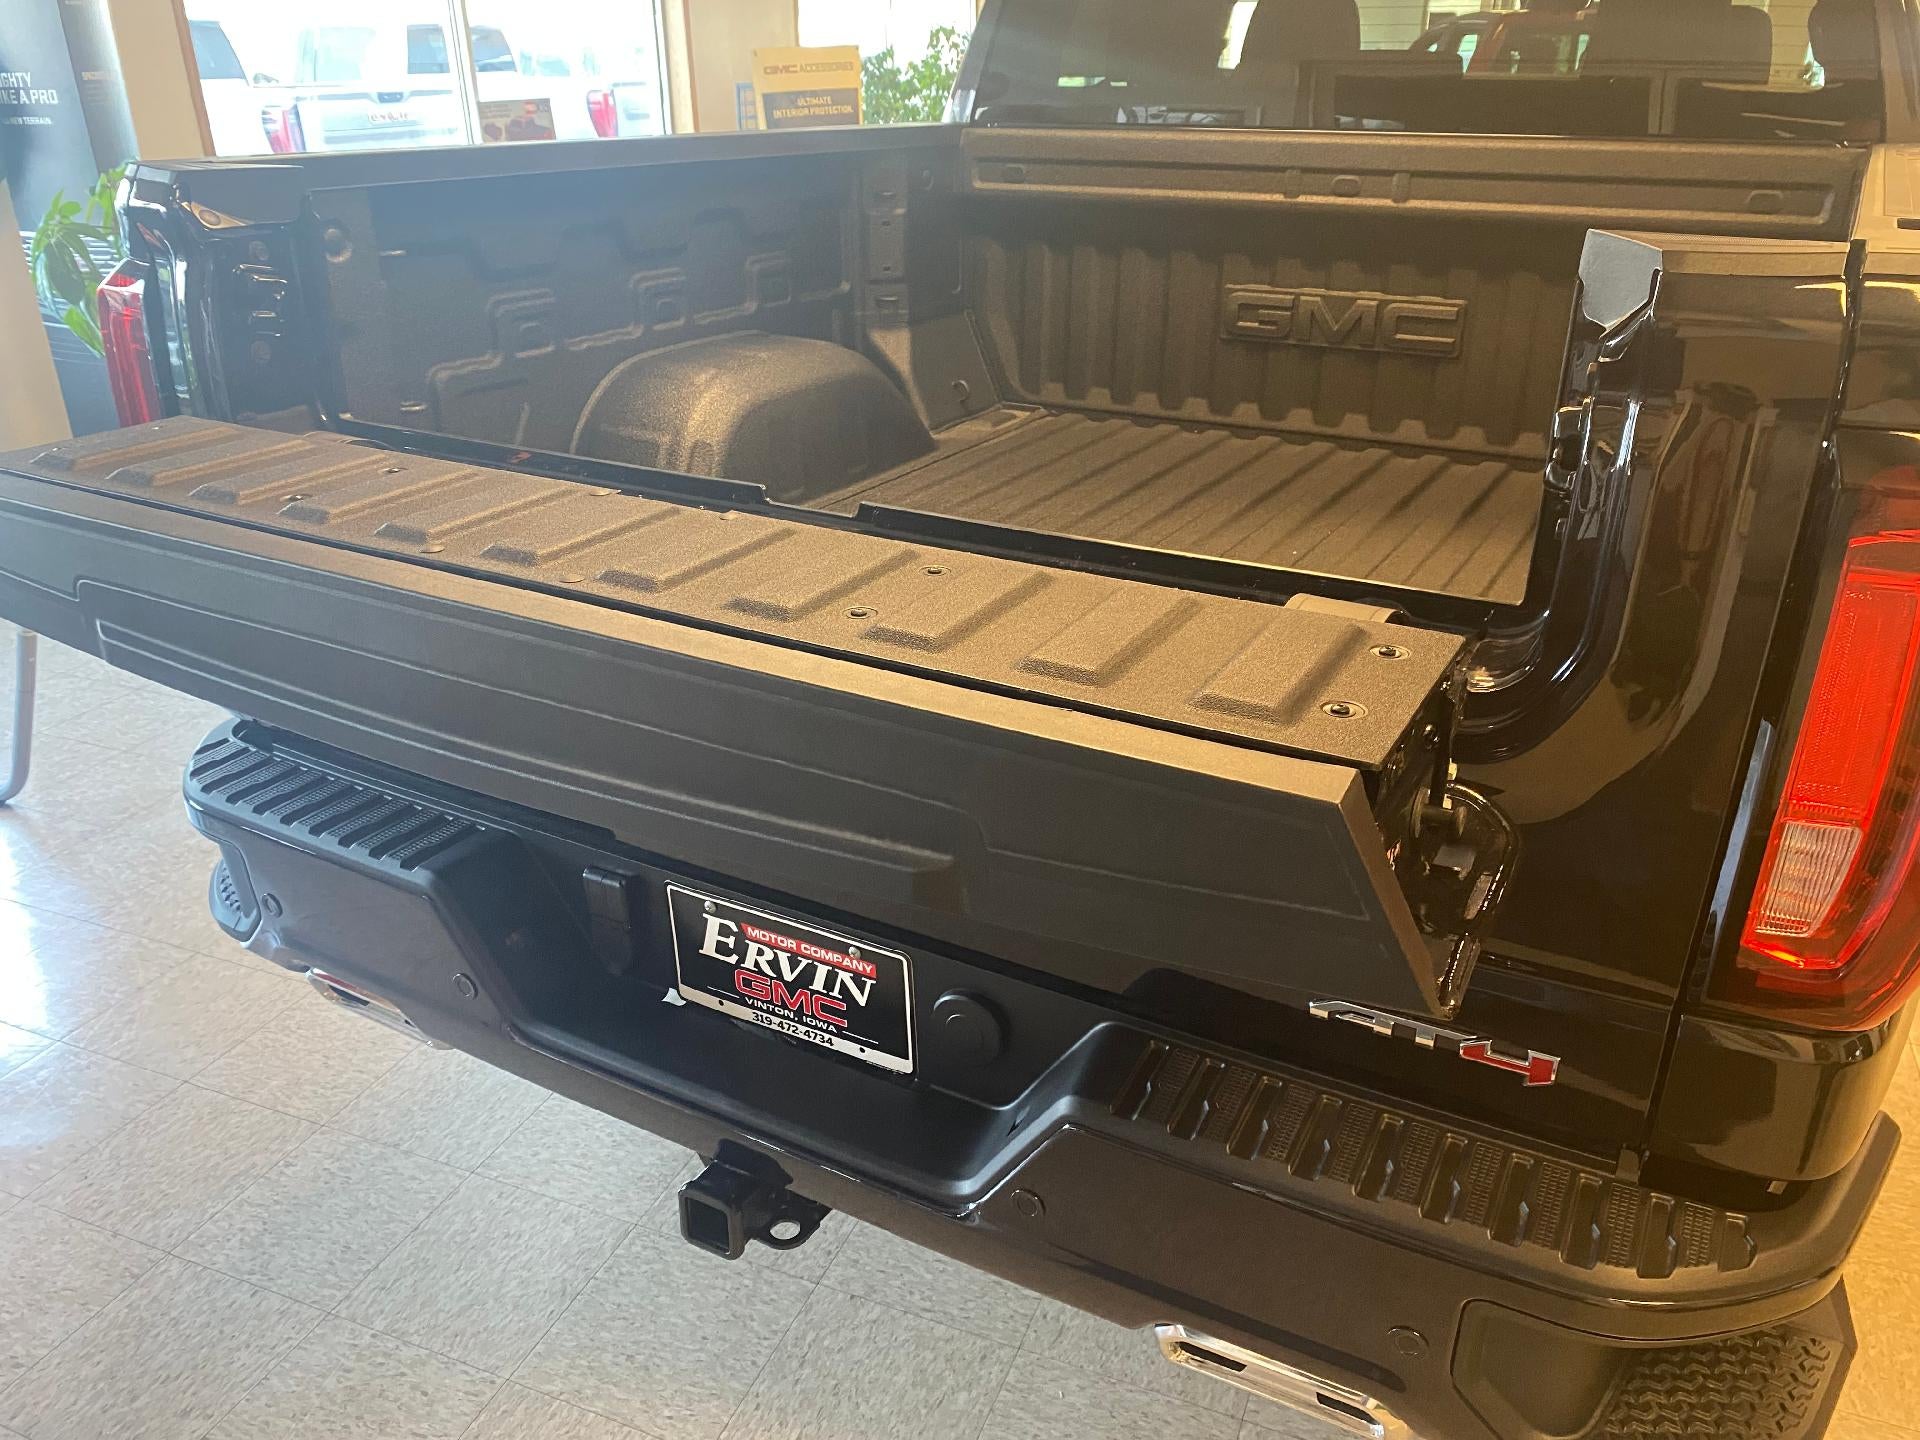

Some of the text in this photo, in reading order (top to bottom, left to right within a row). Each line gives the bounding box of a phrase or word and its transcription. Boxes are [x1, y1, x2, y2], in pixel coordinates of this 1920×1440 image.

[763, 65, 798, 75] GMC
[19, 89, 30, 104] A
[30, 89, 59, 105] PRO
[1227, 290, 1462, 353] GMC
[698, 912, 877, 1007] ERVIN
[747, 926, 874, 974] MOTOR COMPANY
[734, 968, 848, 1028] GMC
[745, 998, 838, 1034] VINTON, IOWA
[751, 1011, 835, 1048] 319-472-4734
